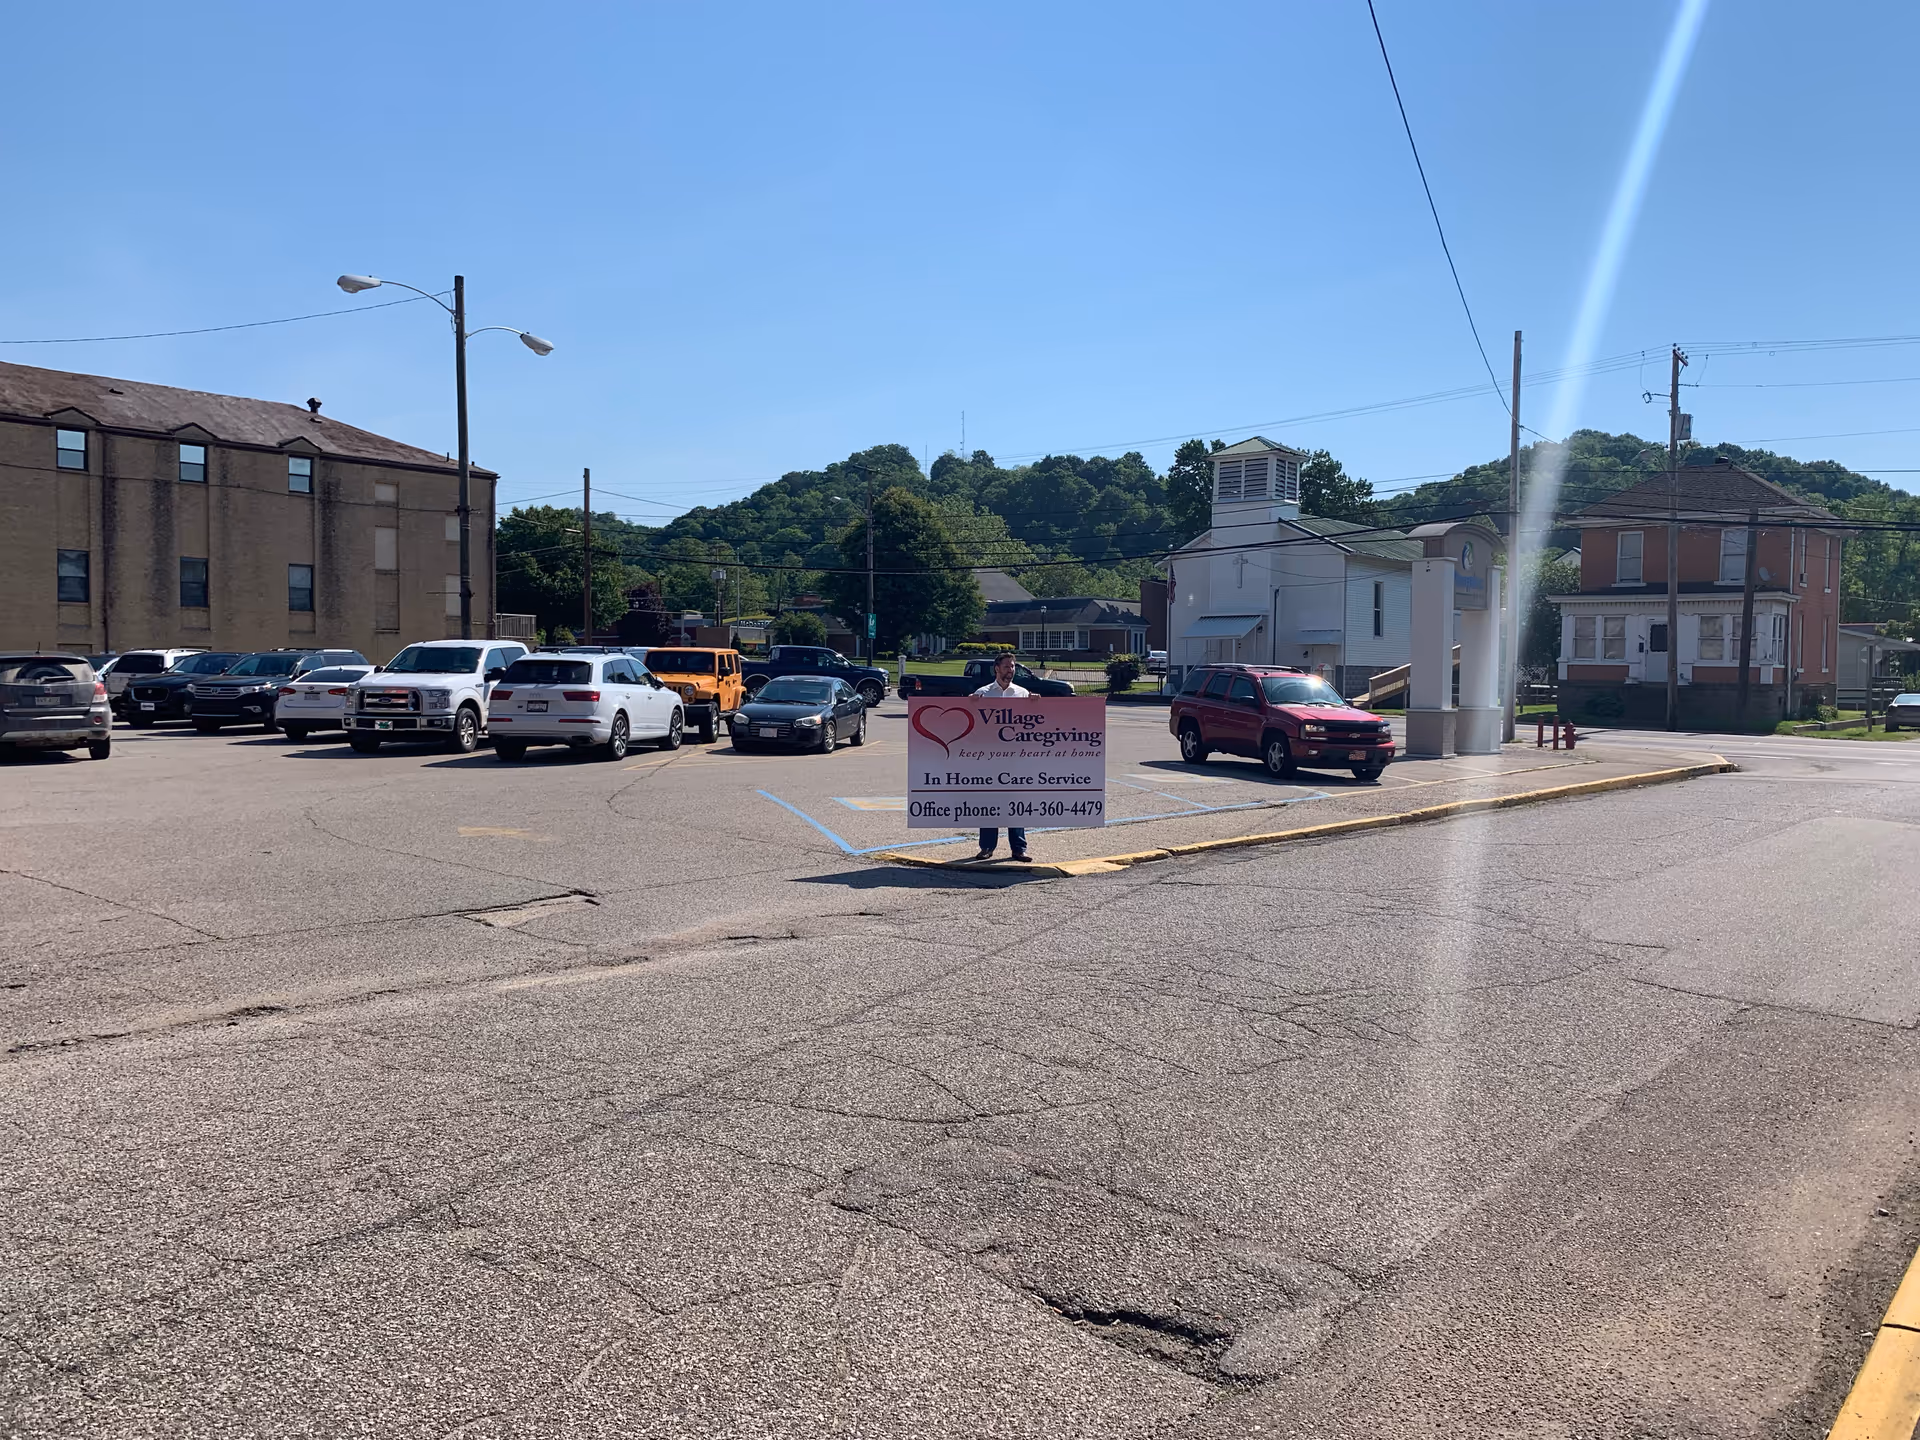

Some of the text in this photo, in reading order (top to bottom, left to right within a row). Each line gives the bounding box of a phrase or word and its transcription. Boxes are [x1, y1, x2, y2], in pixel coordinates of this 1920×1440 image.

[978, 708, 1045, 729] Village
[998, 726, 1102, 746] Caregiving
[959, 749, 1101, 760] keep your heart at home
[924, 772, 1091, 785] In Home Care Service
[910, 801, 1102, 821] Office phone: 304-360-4479
